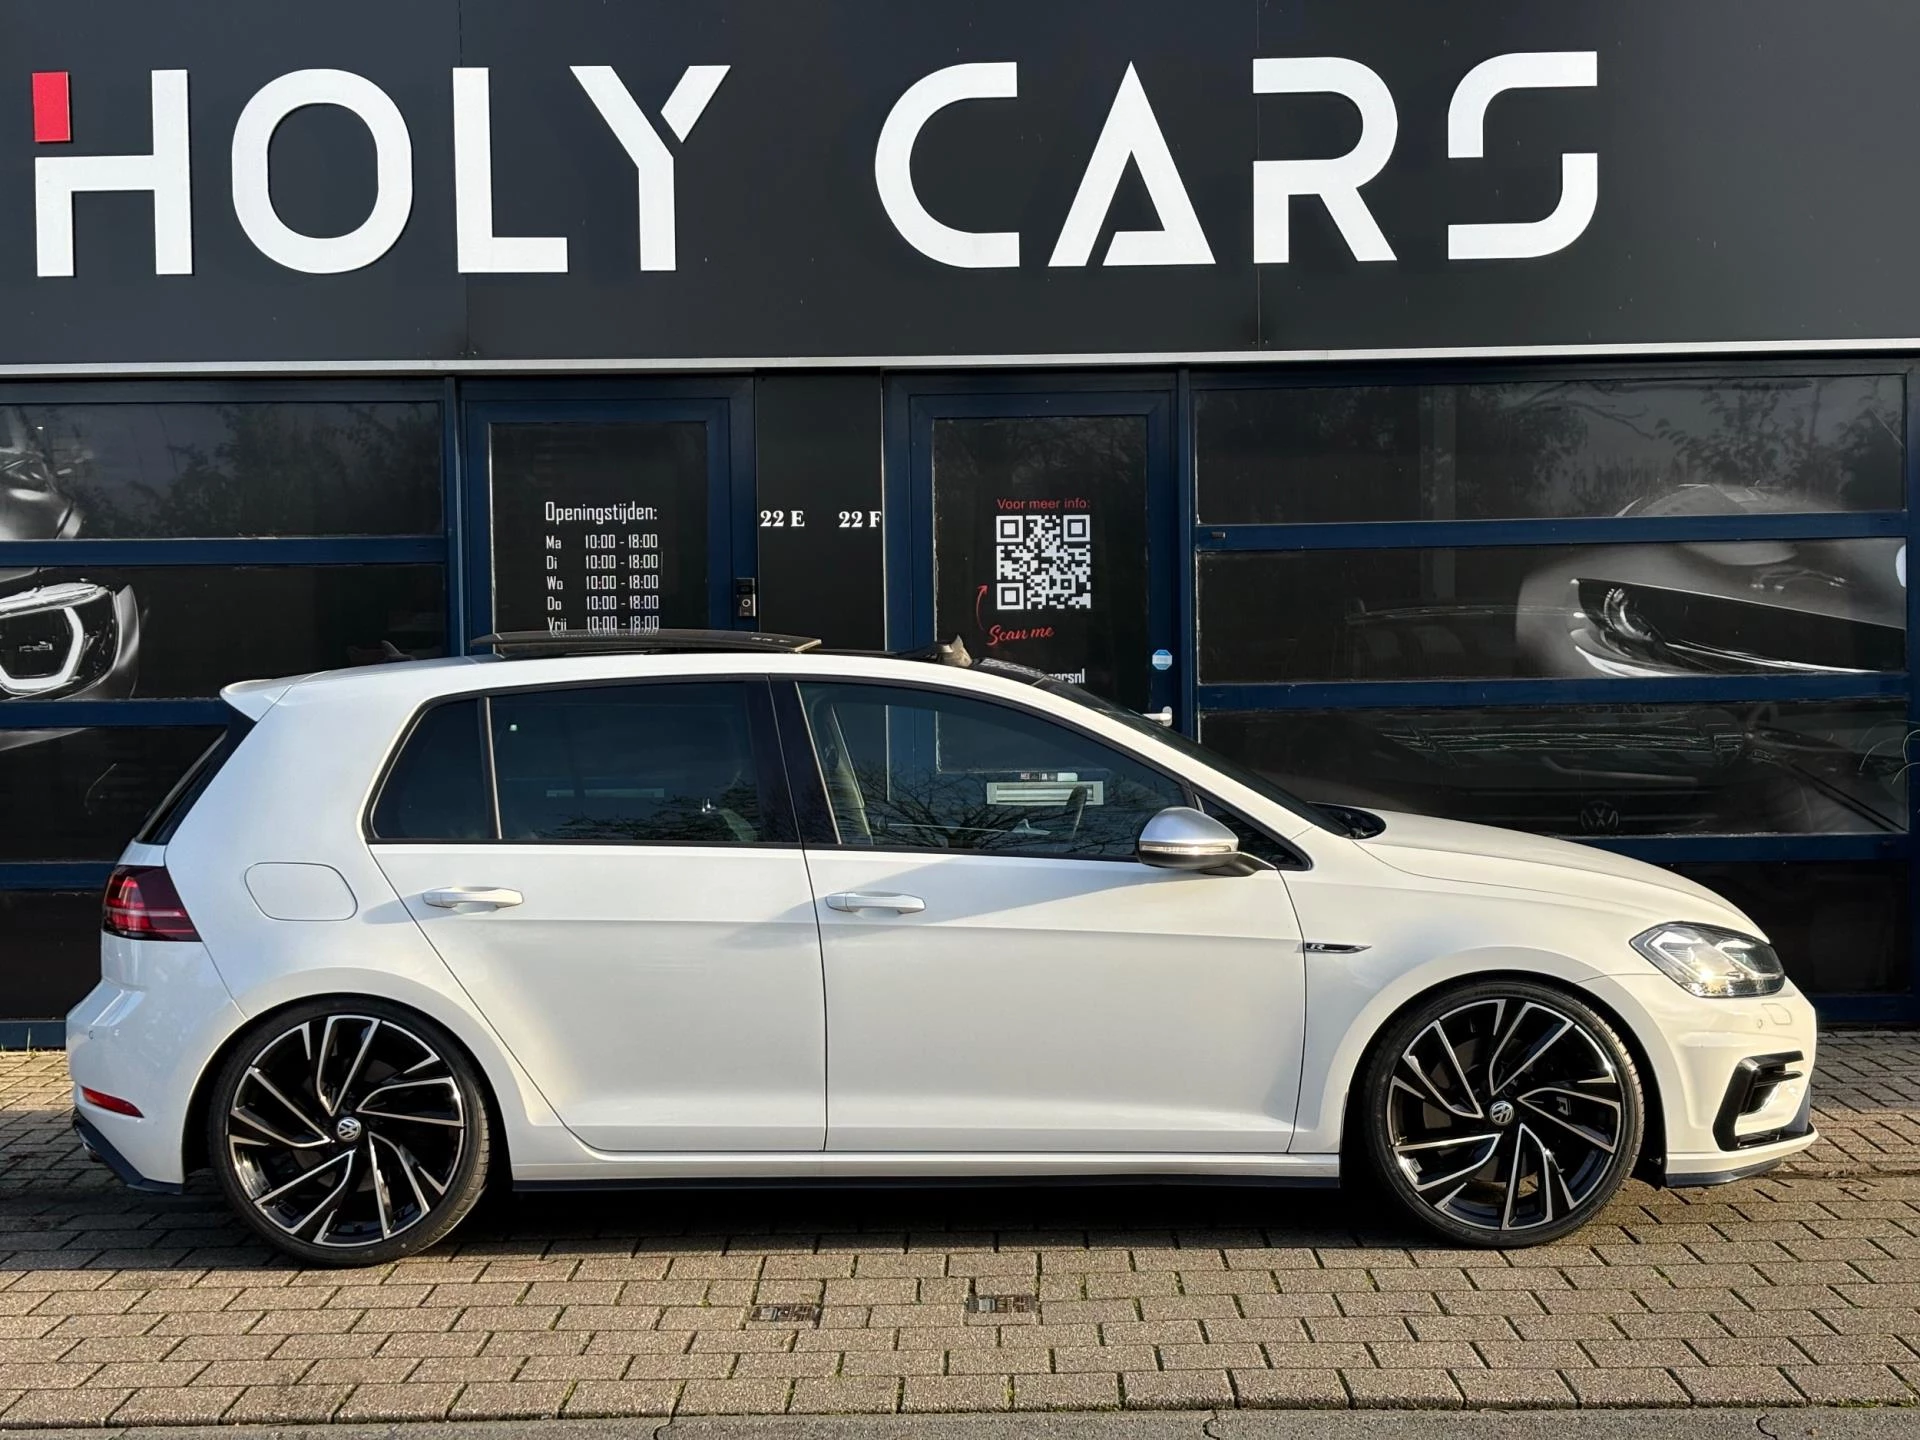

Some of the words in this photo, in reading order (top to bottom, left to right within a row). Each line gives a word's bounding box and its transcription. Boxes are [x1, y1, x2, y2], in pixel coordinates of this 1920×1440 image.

[32, 64, 731, 278] HOLY
[874, 50, 1598, 270] CARS
[996, 499, 1026, 510] Voor
[1029, 499, 1061, 510] meer
[1064, 498, 1091, 509] info:
[545, 500, 658, 526] Openingstijden:
[760, 509, 785, 528] 22
[790, 510, 806, 528] E
[838, 510, 864, 528] 22
[868, 510, 883, 528] F
[546, 535, 562, 549] Ma
[585, 534, 616, 549] 10:00
[628, 534, 658, 549] 18:00
[546, 556, 558, 569] Di
[585, 555, 616, 569] 10:00
[628, 554, 659, 569] 18:00
[546, 575, 564, 590] Wo
[586, 575, 617, 590] 10:00
[629, 574, 659, 590] 18:00
[547, 596, 562, 610] Do
[586, 595, 617, 610] 10:00
[629, 594, 659, 610] 18:00
[986, 624, 1029, 646] Scan
[1030, 626, 1055, 639] me
